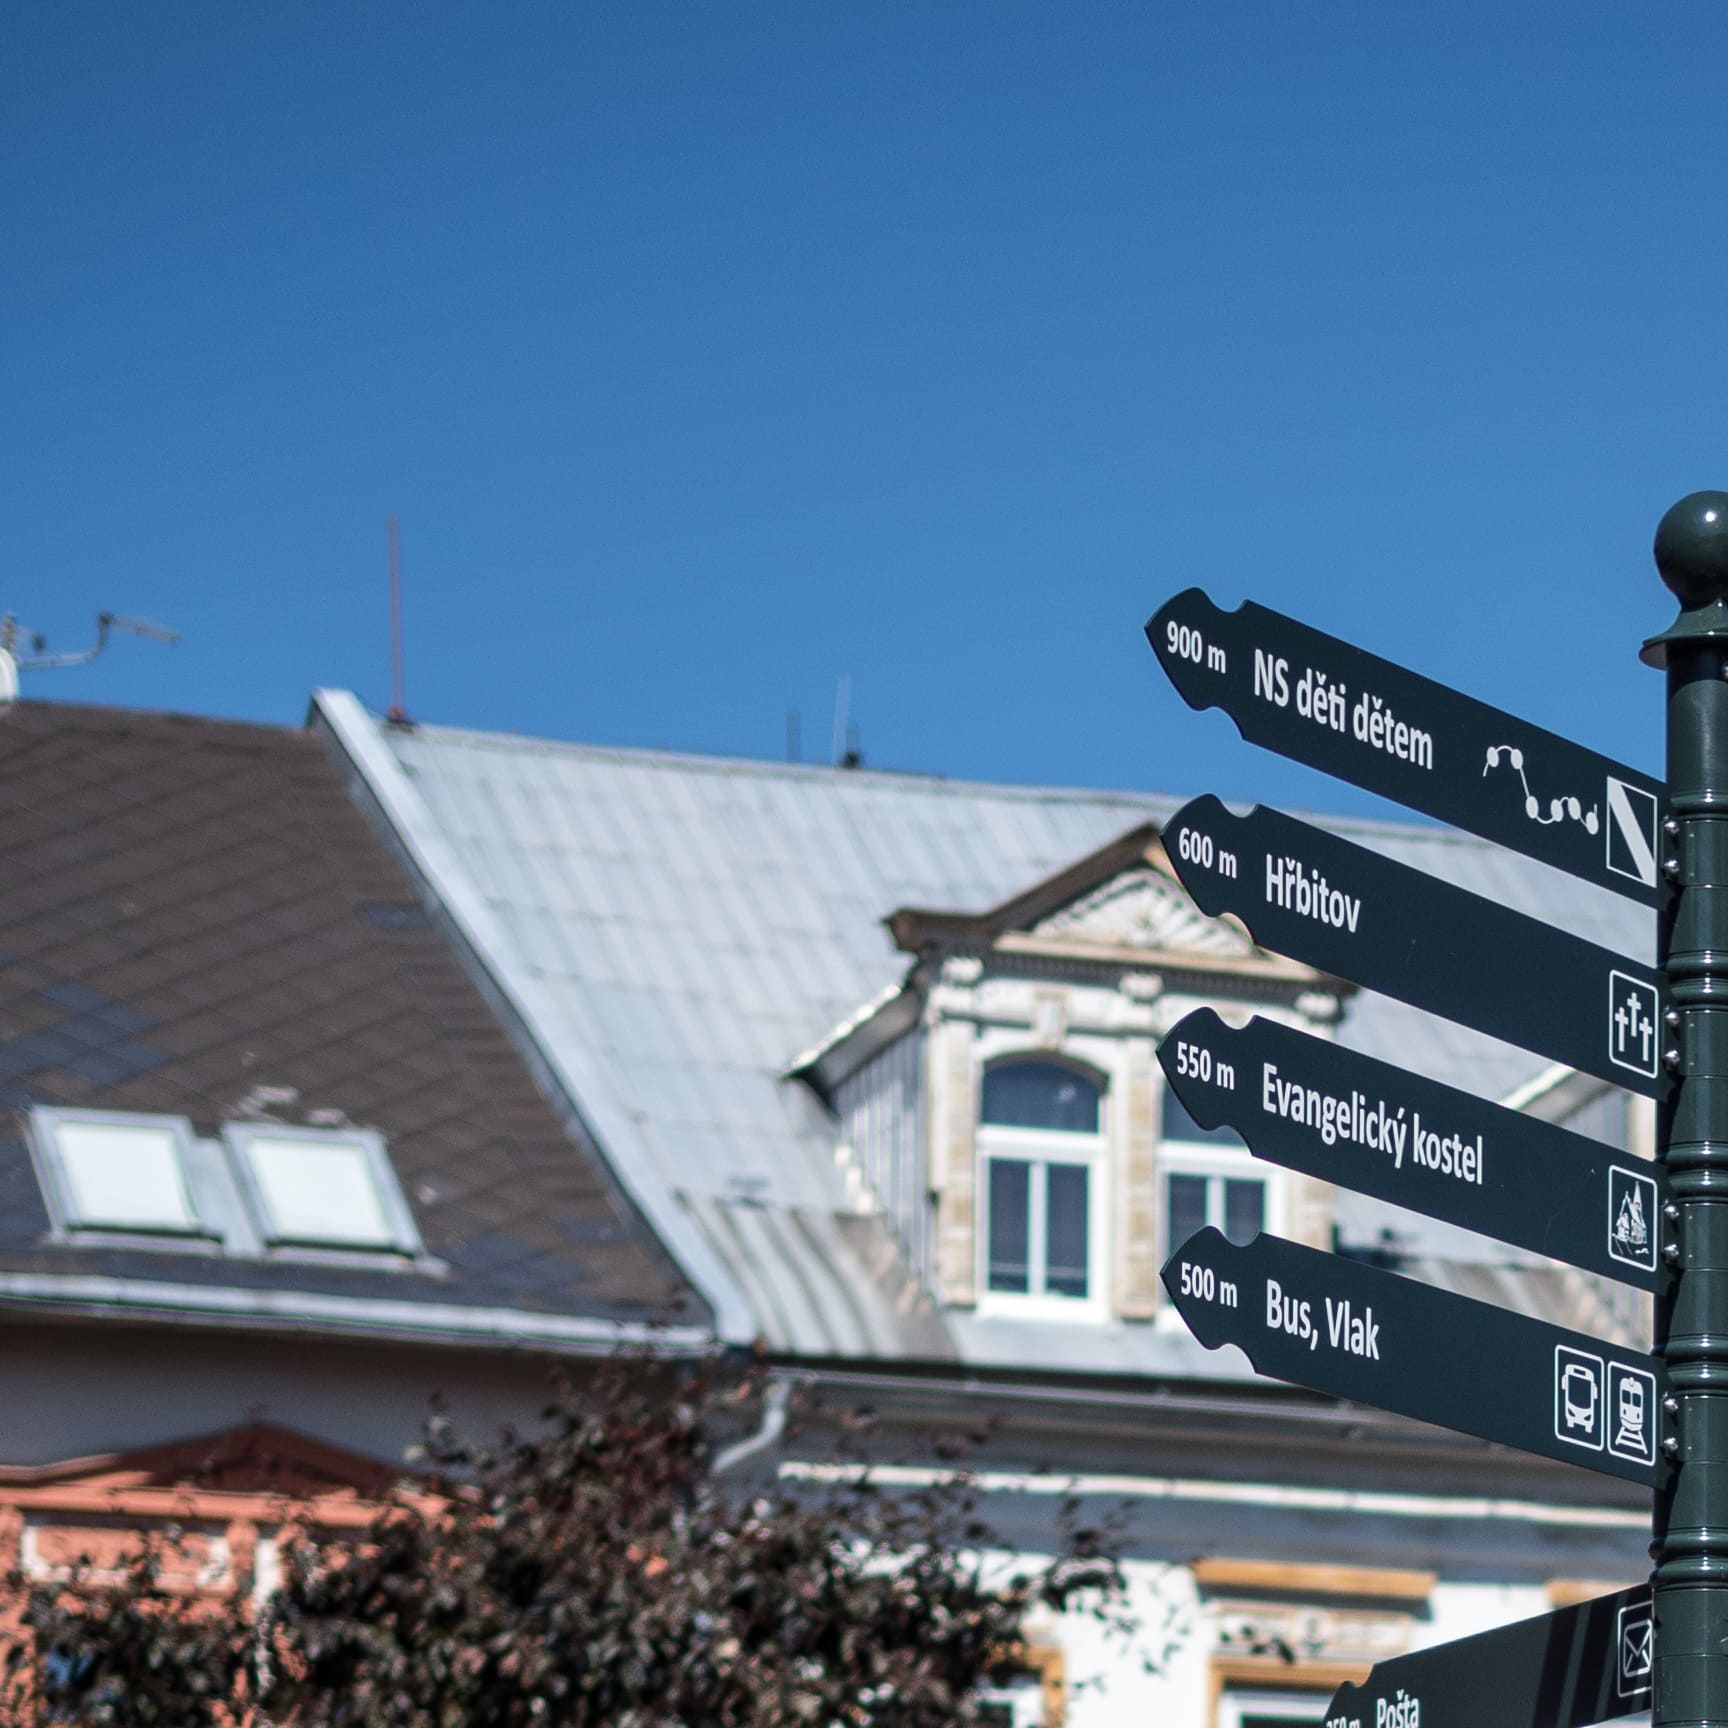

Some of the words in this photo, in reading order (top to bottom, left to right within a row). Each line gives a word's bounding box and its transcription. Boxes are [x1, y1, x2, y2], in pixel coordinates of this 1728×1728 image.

[1166, 620, 1203, 664] 900
[1207, 644, 1226, 674] m
[1254, 648, 1290, 707] NS
[1296, 667, 1346, 733] děti
[1352, 692, 1433, 770] dětem
[1178, 826, 1214, 871] 600
[1218, 850, 1237, 879] m
[1266, 853, 1361, 933] Hřbitov
[1177, 1041, 1212, 1082] 550
[1216, 1064, 1235, 1090] m
[1262, 1062, 1407, 1170] Evangelický
[1413, 1112, 1483, 1185] kostel
[1180, 1261, 1215, 1302] 500
[1219, 1280, 1238, 1308] m
[1266, 1278, 1319, 1351] Bus,
[1325, 1297, 1380, 1361] Vlak
